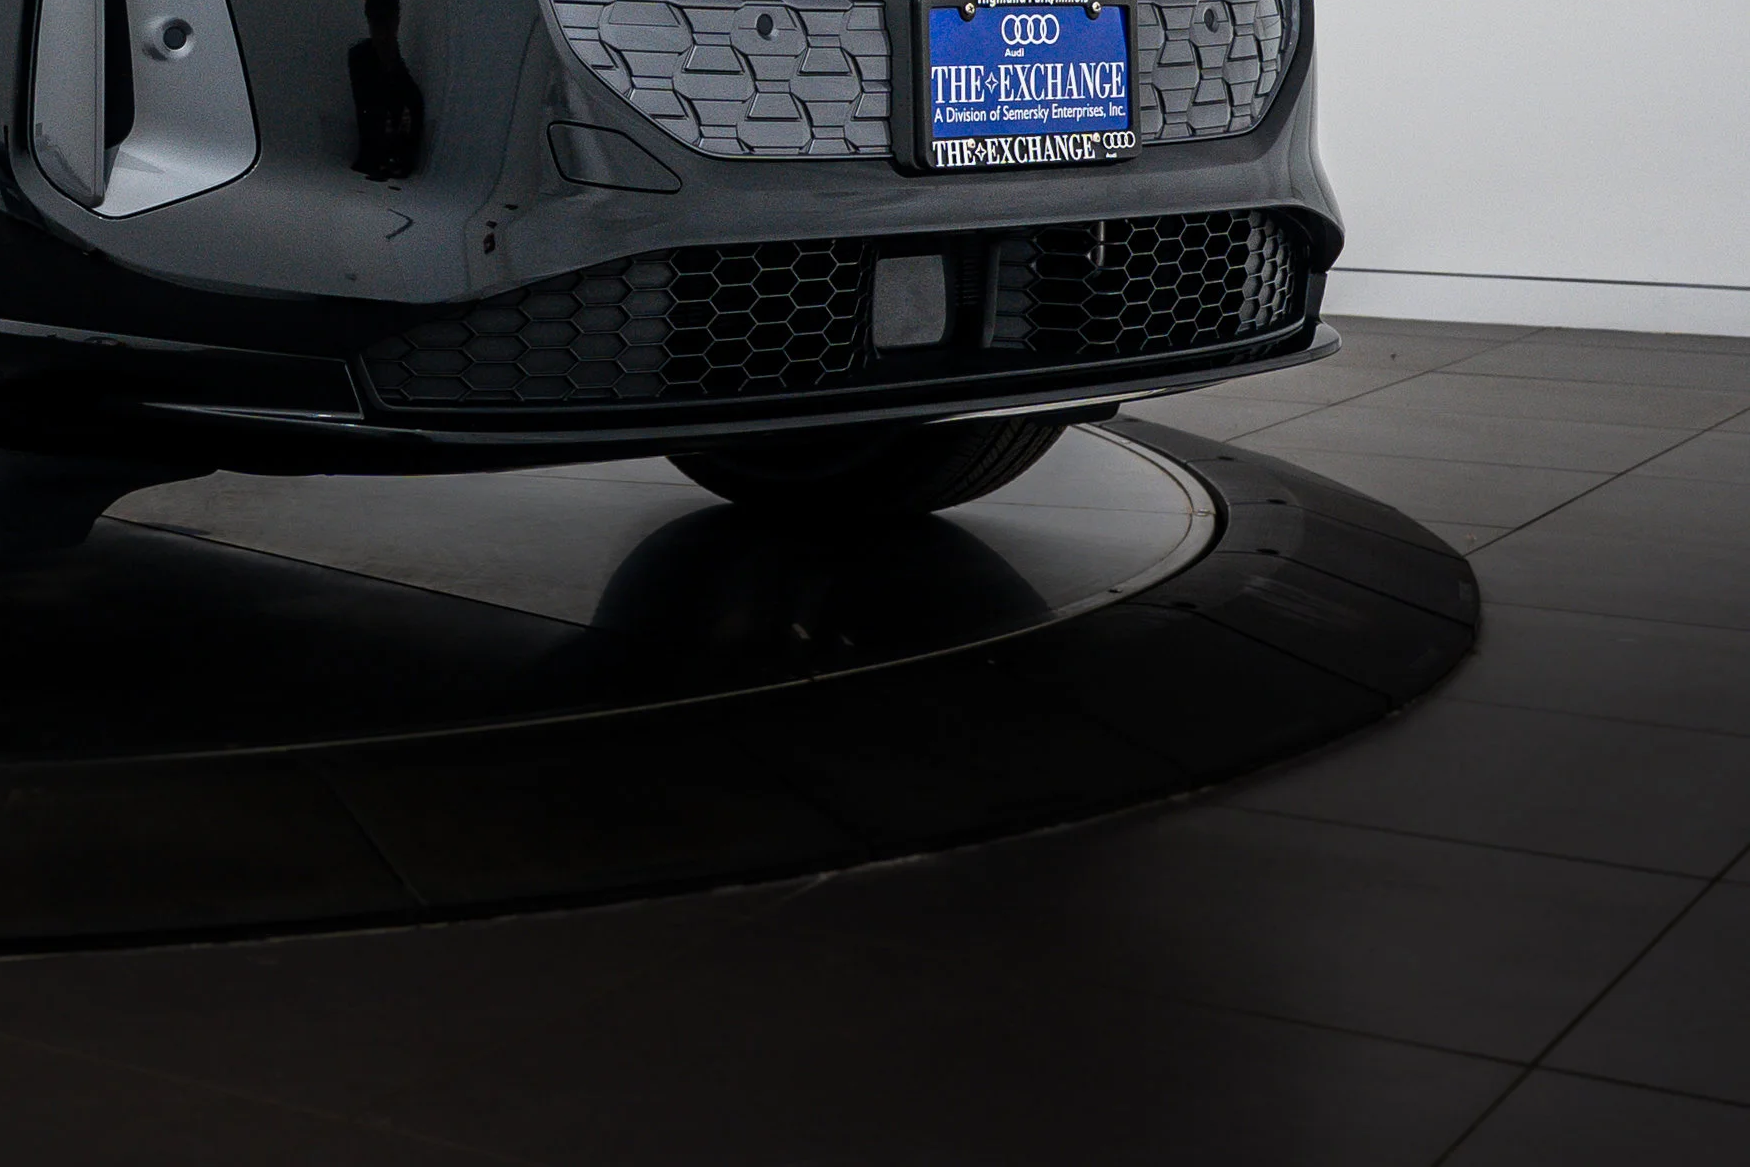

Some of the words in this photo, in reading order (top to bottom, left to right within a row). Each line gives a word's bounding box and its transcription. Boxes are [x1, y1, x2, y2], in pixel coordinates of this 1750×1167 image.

[1005, 48, 1025, 57] Audi
[931, 65, 985, 104] THE
[998, 62, 1126, 102] EXCHANGE
[934, 107, 943, 123] A
[946, 106, 987, 123] Division
[990, 105, 1001, 121] of
[1002, 105, 1049, 124] Semersky
[1052, 103, 1107, 121] Enterprises,
[1109, 102, 1126, 117] Inc.
[932, 138, 977, 168] THE
[986, 133, 1096, 166] EXCHANGE
